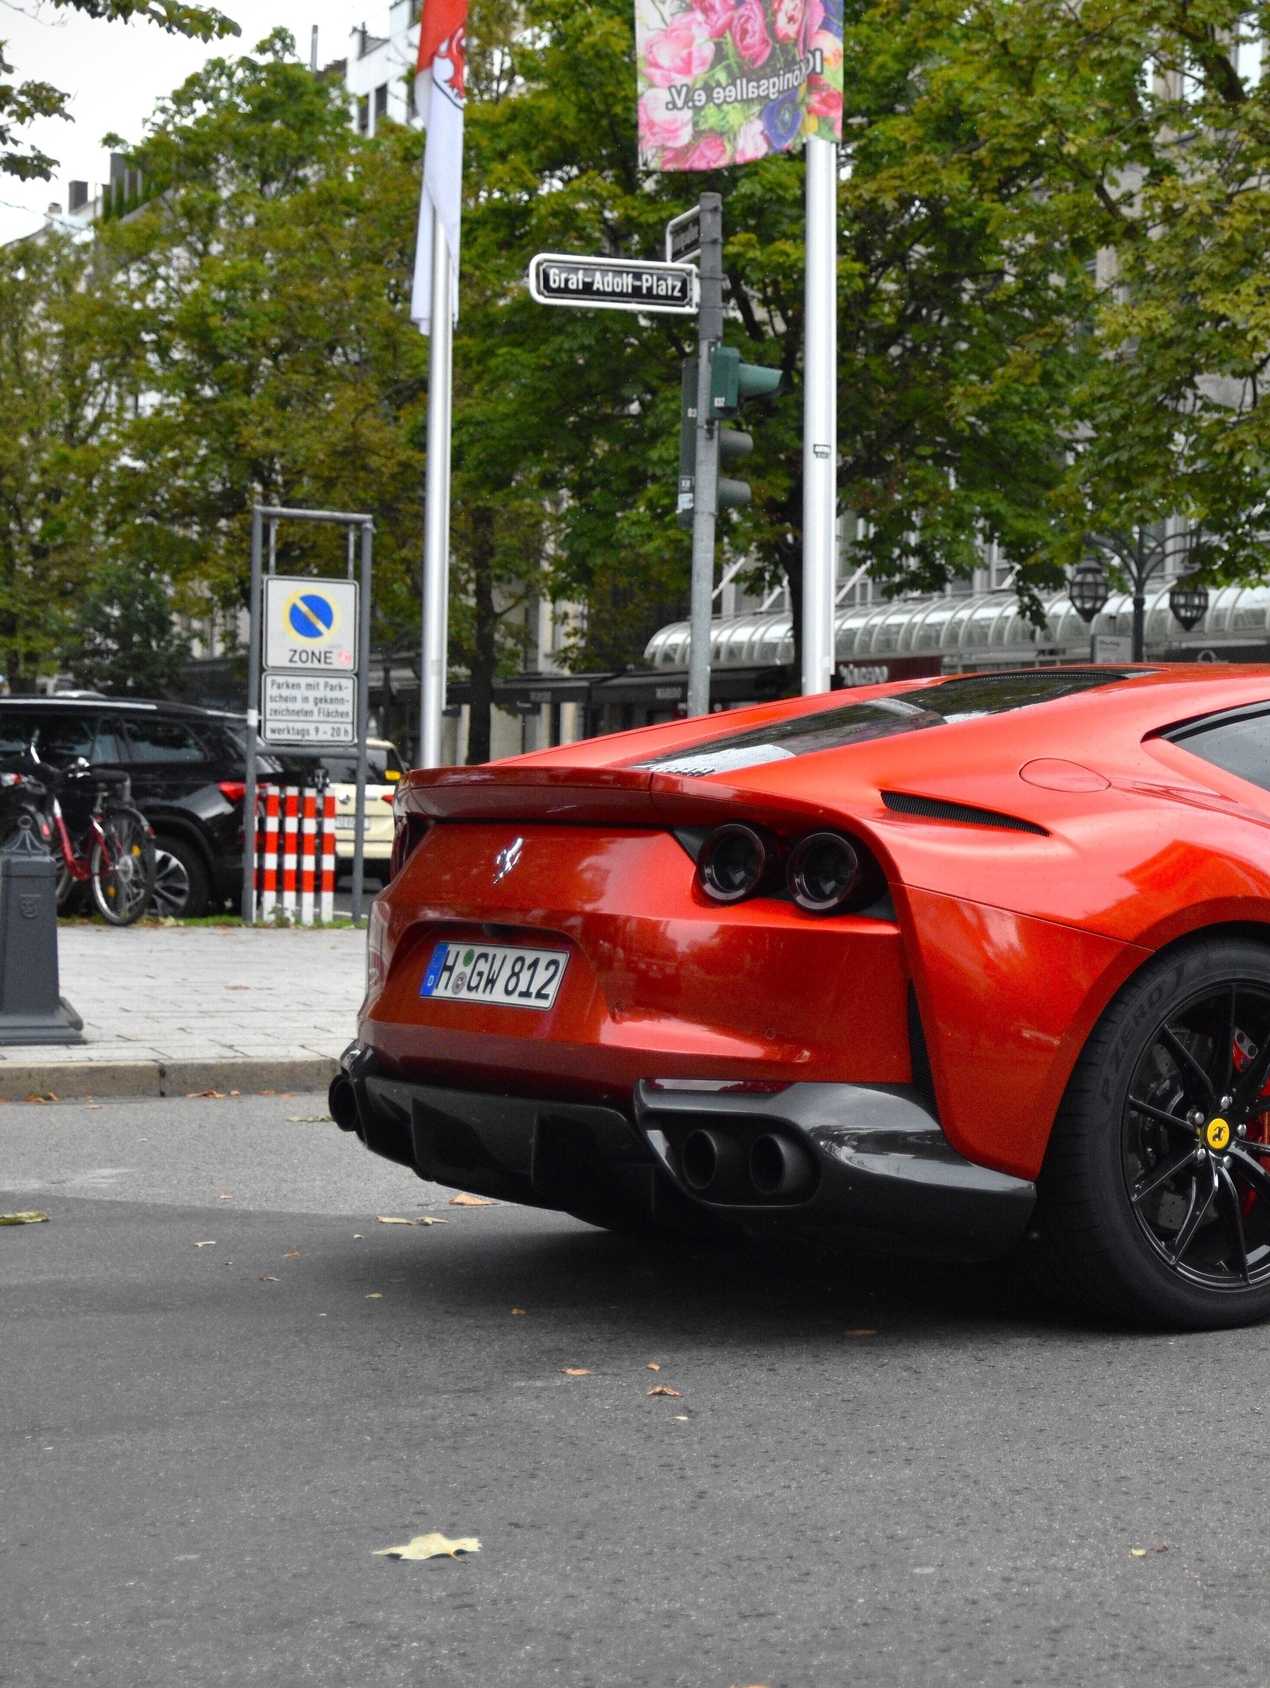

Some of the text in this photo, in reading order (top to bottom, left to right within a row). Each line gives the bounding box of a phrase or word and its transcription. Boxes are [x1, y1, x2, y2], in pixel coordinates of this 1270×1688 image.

[550, 267, 683, 297] Graf-Adolf-Platz
[288, 649, 333, 665] ZONE
[270, 679, 349, 692] Parken mit Park-
[269, 693, 350, 707] schein in gekenn-
[269, 707, 350, 719] zeichneten Flächen
[269, 725, 310, 738] werktags
[314, 726, 320, 737] 9
[330, 726, 341, 738] 20
[343, 726, 350, 738] h
[435, 950, 560, 1000] H GW 812
